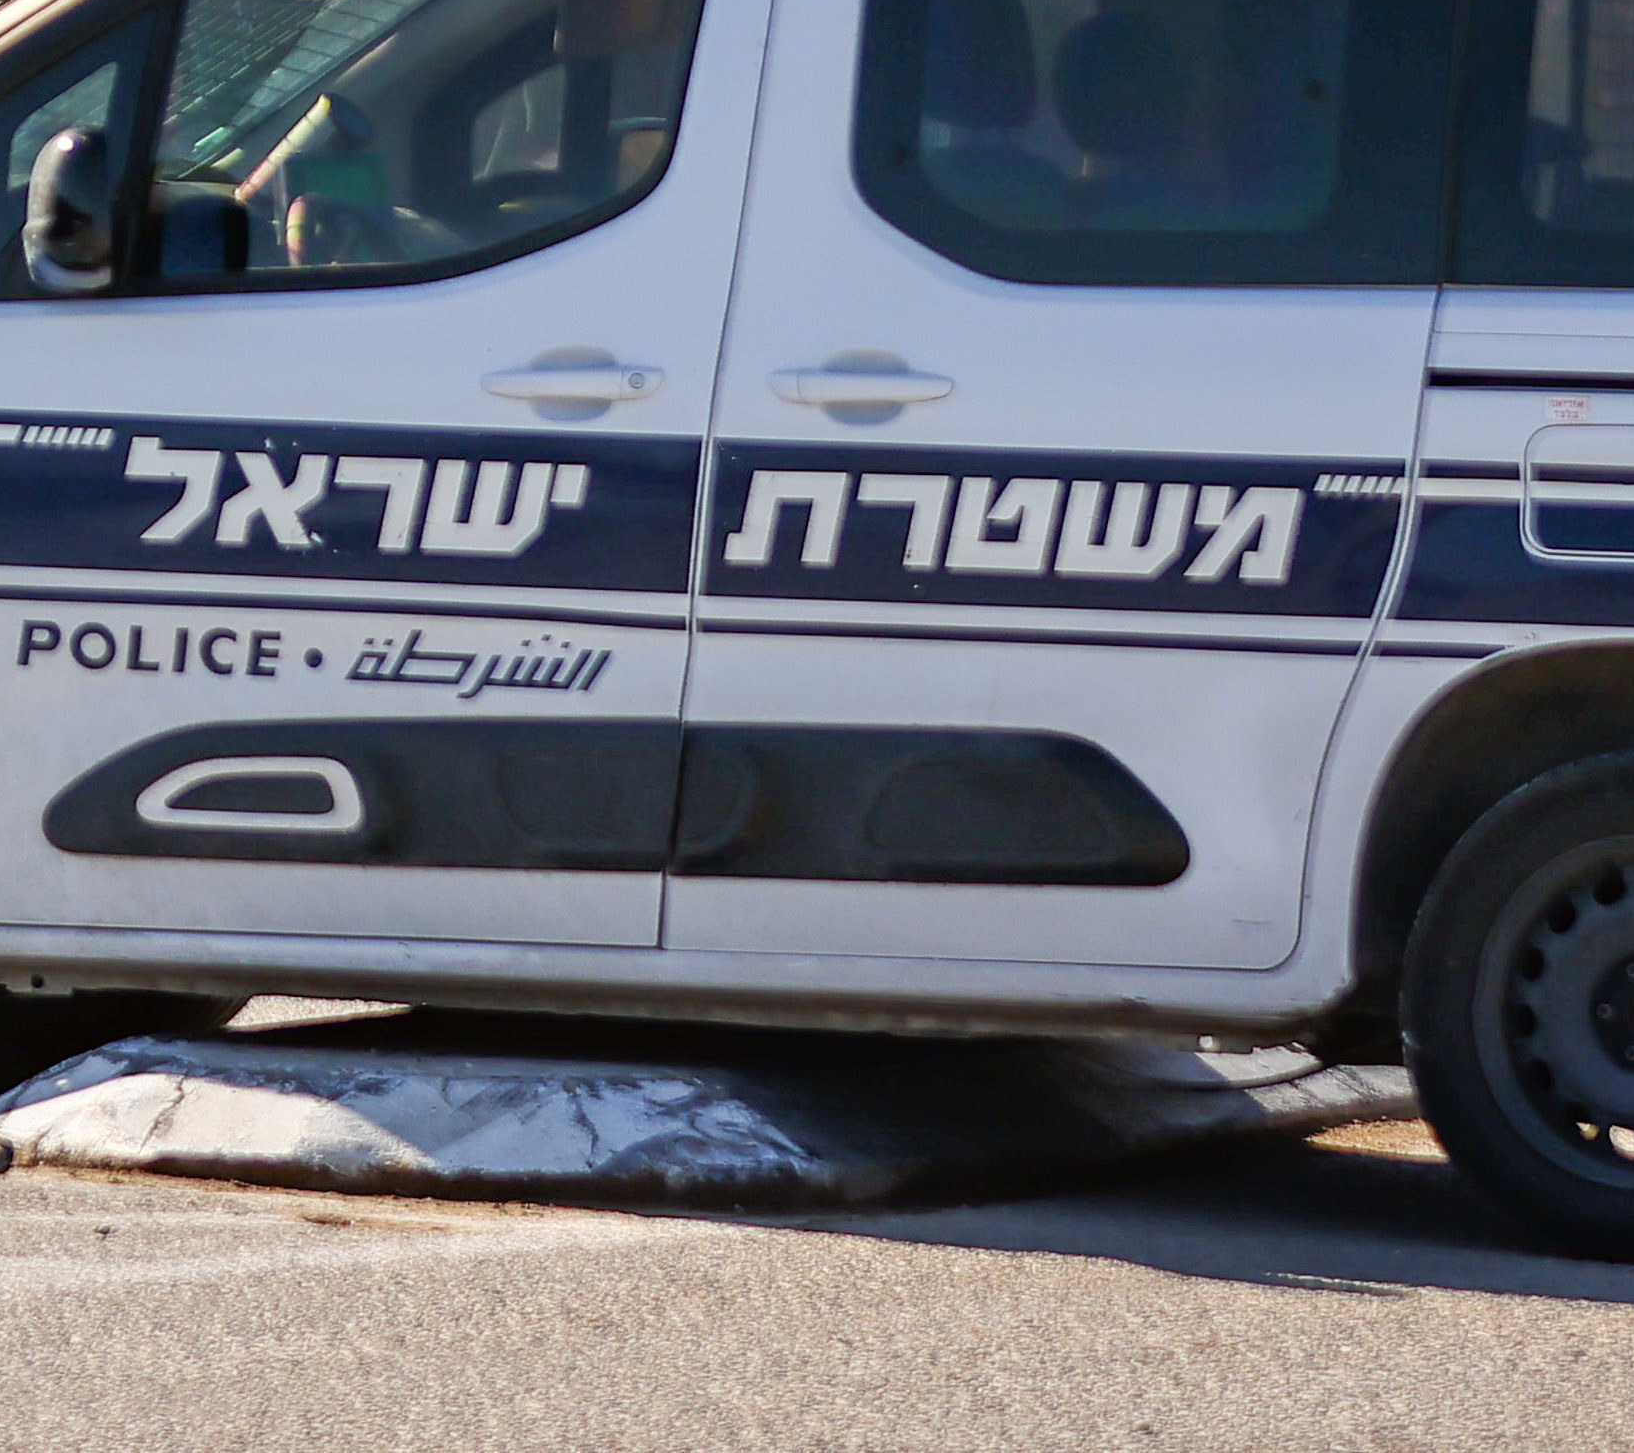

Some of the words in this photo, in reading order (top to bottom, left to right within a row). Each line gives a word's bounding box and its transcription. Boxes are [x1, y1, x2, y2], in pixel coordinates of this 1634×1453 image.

[124, 435, 590, 558] ישראל
[723, 469, 1301, 585] משטרת
[16, 619, 281, 677] POLICE
[344, 629, 613, 699] الشرطة
